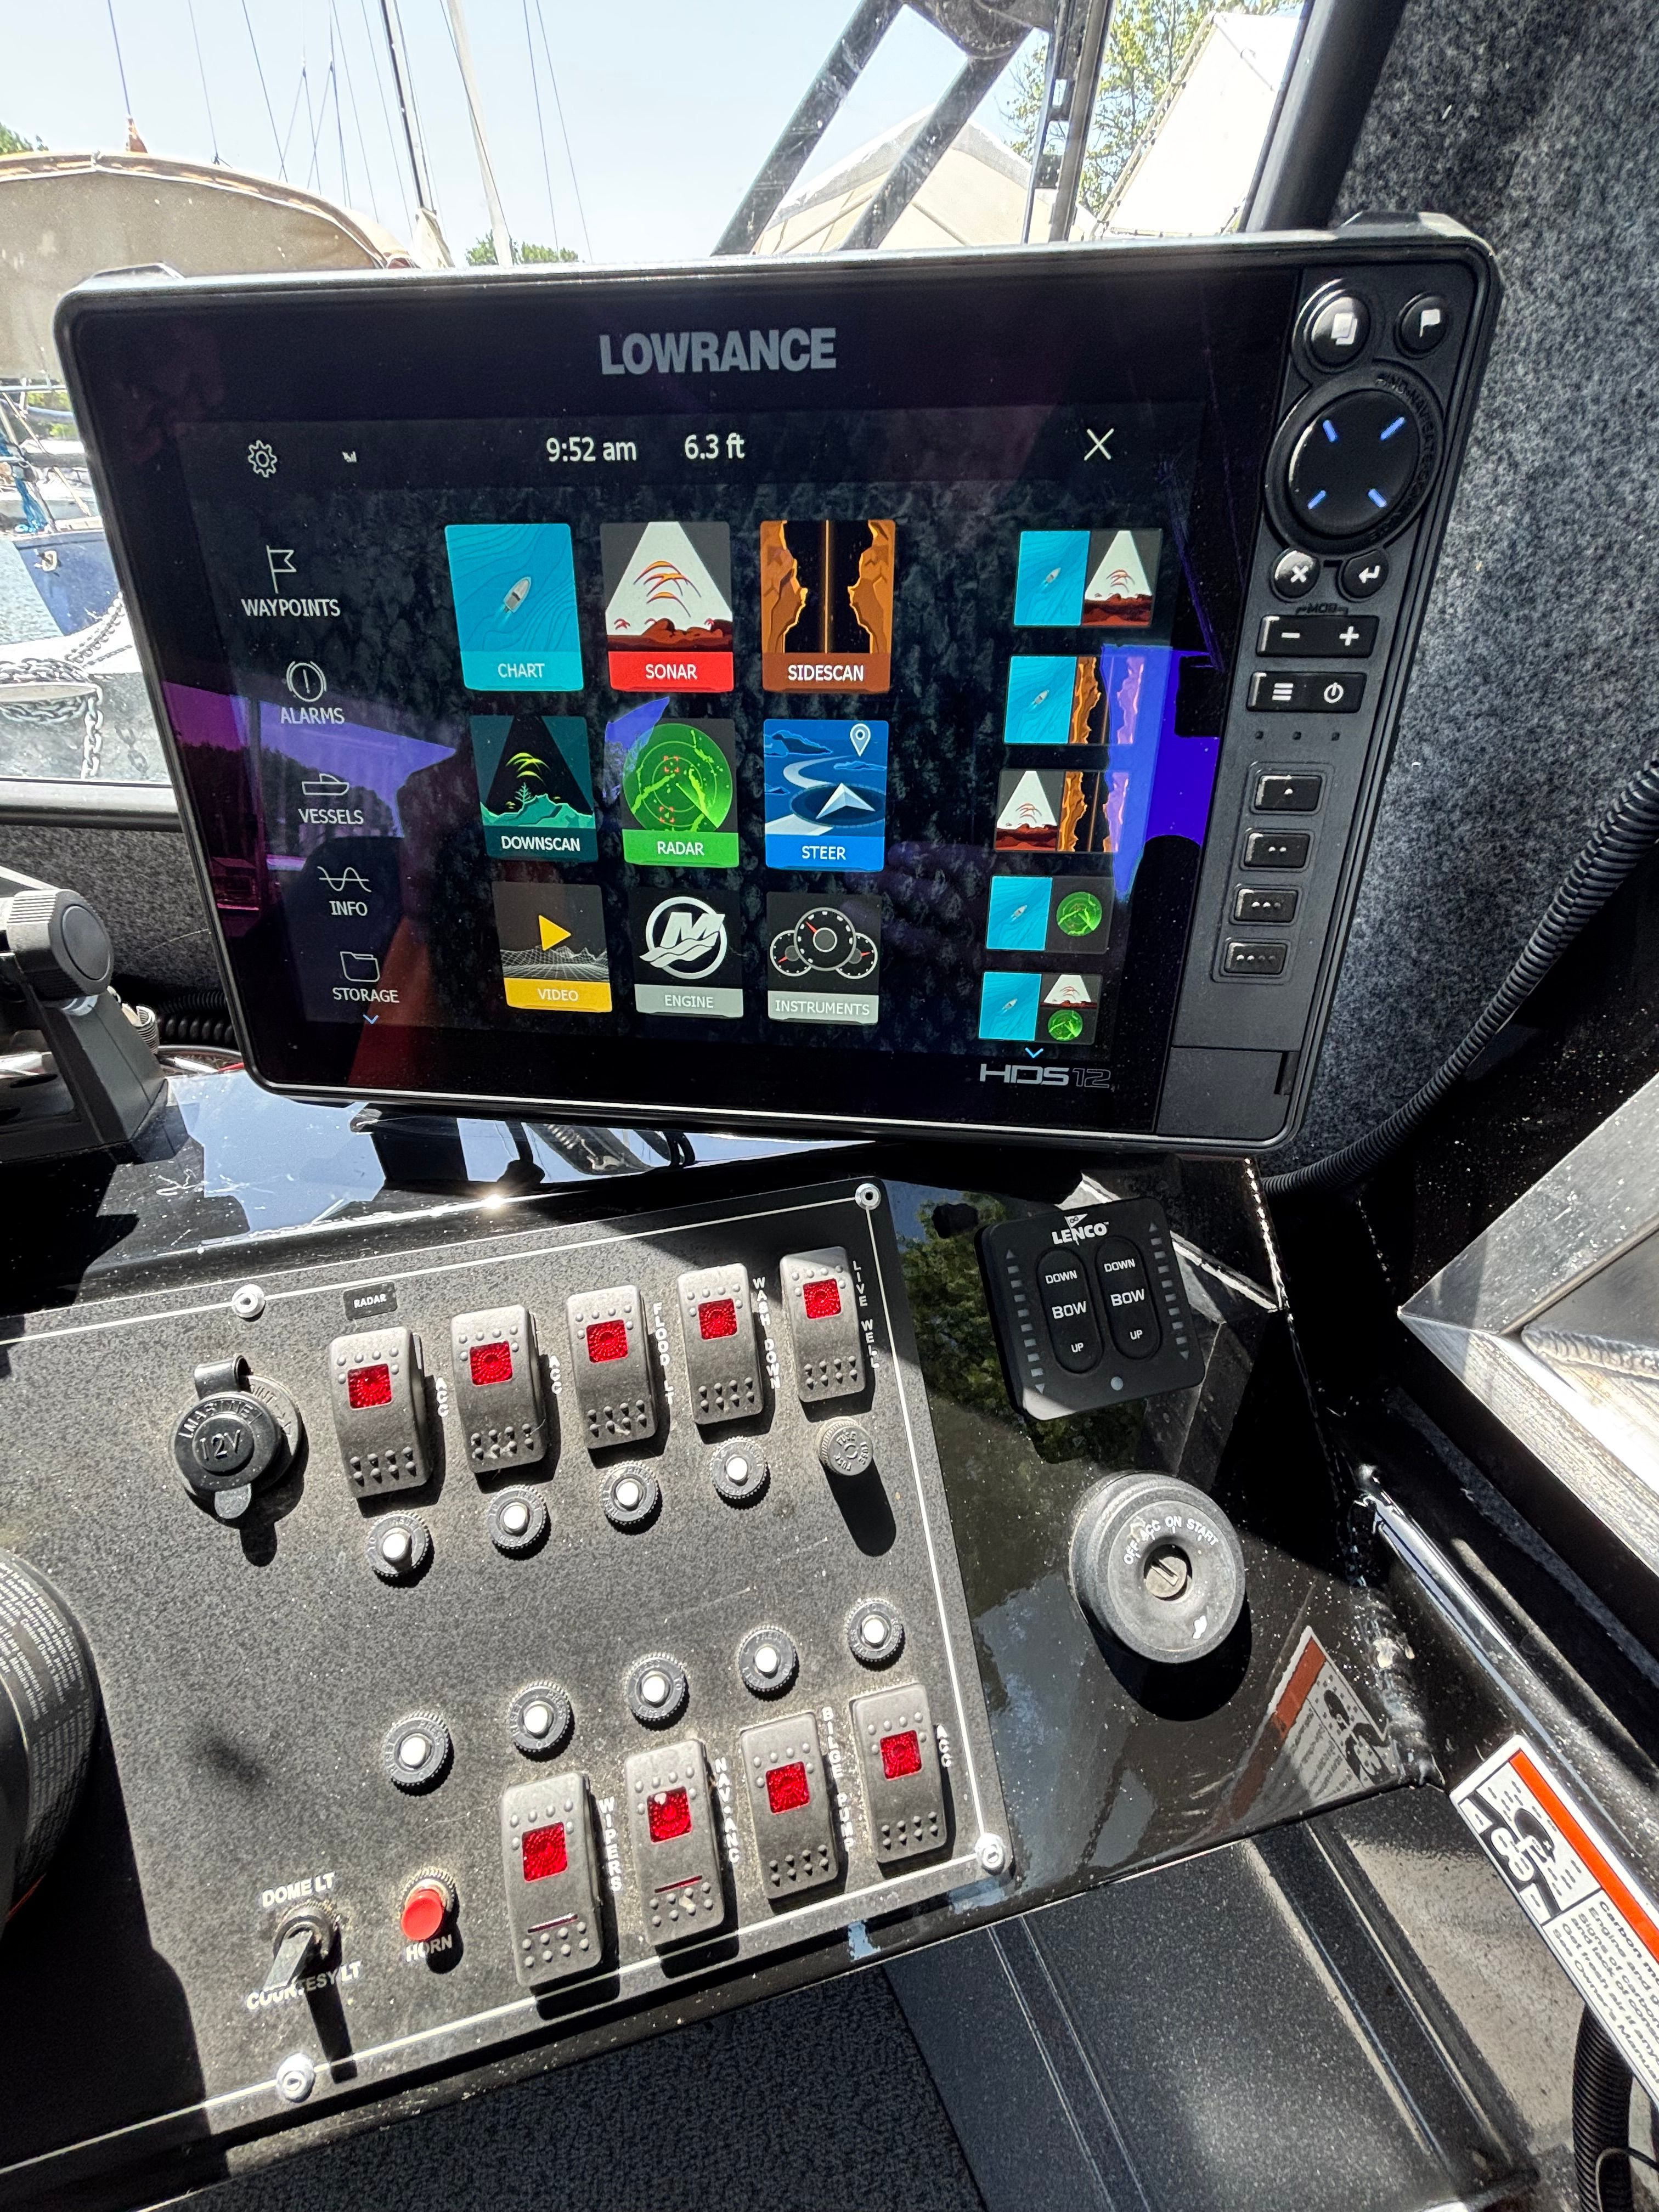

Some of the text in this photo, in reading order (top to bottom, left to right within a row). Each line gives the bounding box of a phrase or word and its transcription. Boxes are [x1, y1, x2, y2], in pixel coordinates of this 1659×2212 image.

[600, 328, 837, 375] LOWRANCE
[546, 437, 637, 462] 9:52 am
[685, 433, 745, 459] 6.3 ft
[241, 599, 341, 617] WAYPOINTS
[498, 663, 545, 679] CHART
[645, 663, 698, 680] SONAR
[788, 664, 865, 682] SIDESCAN
[280, 707, 345, 725] ALARMS
[298, 809, 364, 825] VESSELS
[501, 835, 581, 853] DOWNSCAN
[657, 841, 705, 856] RADAR
[802, 845, 847, 861] STEER
[329, 901, 369, 917] INFO
[332, 987, 399, 1004] STORAGE
[537, 988, 579, 1002] VIDEO
[664, 994, 714, 1009] ENGINE
[775, 999, 870, 1016] INSTRUMENTS
[1104, 1259, 1136, 1272] DOWN
[1045, 1270, 1077, 1284] DOWN
[353, 1293, 387, 1308] RADAR
[1110, 1289, 1145, 1307] BOW
[853, 1260, 880, 1369] LIVE WELL
[1052, 1301, 1086, 1319] BOW
[753, 1277, 781, 1389] WASH DOWN
[1130, 1329, 1143, 1340] UP
[653, 1302, 674, 1405] FLOOD LT
[1070, 1342, 1084, 1353] UP
[549, 1355, 562, 1395] ACC
[435, 1377, 449, 1418] ACC
[199, 1429, 241, 1460] 12V
[1140, 1520, 1161, 1541] ACC
[1165, 1516, 1182, 1527] ON
[1186, 1519, 1219, 1546] START
[1124, 1539, 1139, 1565] OFF
[822, 1706, 855, 1852] BILGE PUMP
[599, 1796, 623, 1893] WIPERS
[262, 1872, 335, 1908] DOME LT
[1599, 1900, 1642, 1959] Carbon
[406, 1934, 453, 1962] HORN
[1578, 1913, 1609, 1954] Signs
[1609, 1956, 1623, 1971] of
[1588, 1906, 1652, 1991] Engine and
[1562, 1923, 1582, 1949] Get
[1581, 1951, 1609, 1989] fresh
[1609, 1992, 1626, 2011] air
[1571, 1918, 1593, 1944] and
[1592, 1946, 1615, 1978] lack
[1615, 1980, 1630, 1995] of
[341, 1961, 362, 1982] LT
[1553, 1928, 1573, 1957] See
[1574, 1959, 1617, 2022] Owner's
